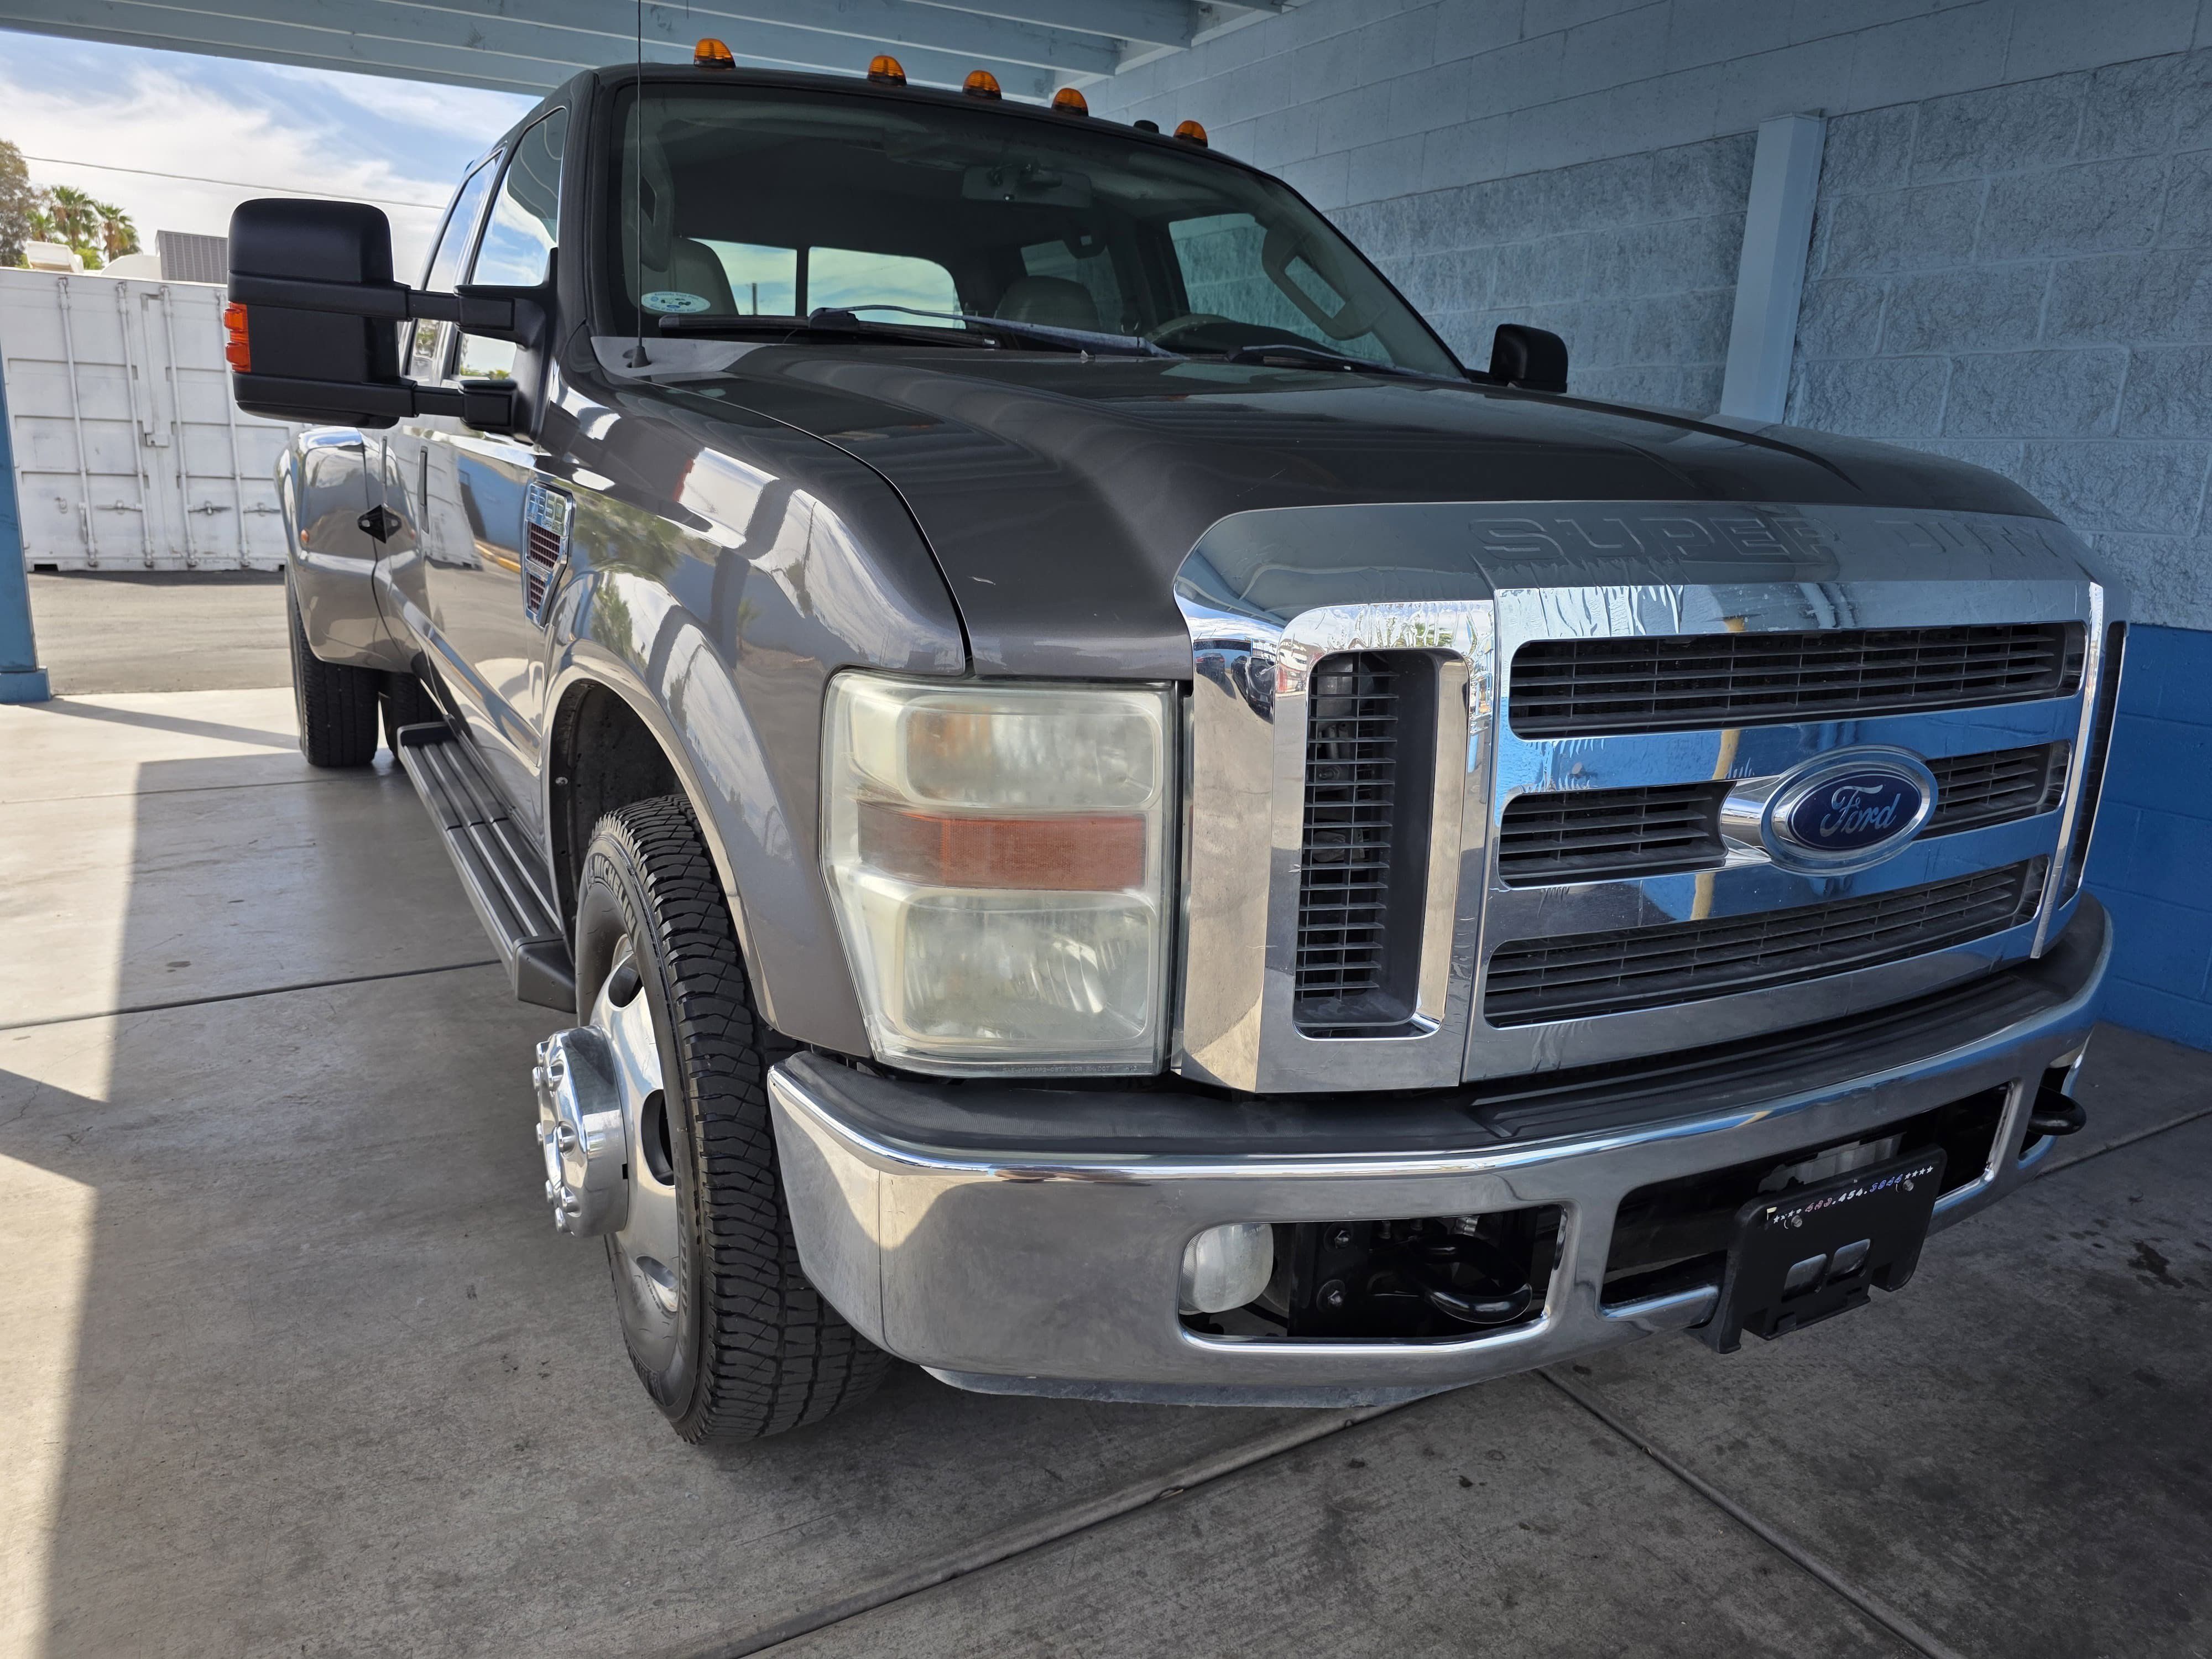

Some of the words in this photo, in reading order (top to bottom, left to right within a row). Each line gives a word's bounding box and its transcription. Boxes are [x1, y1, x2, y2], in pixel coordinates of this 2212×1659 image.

[1468, 518, 1848, 560] SUPER
[1819, 784, 1901, 837] Ford
[594, 854, 637, 935] MICHELIN
